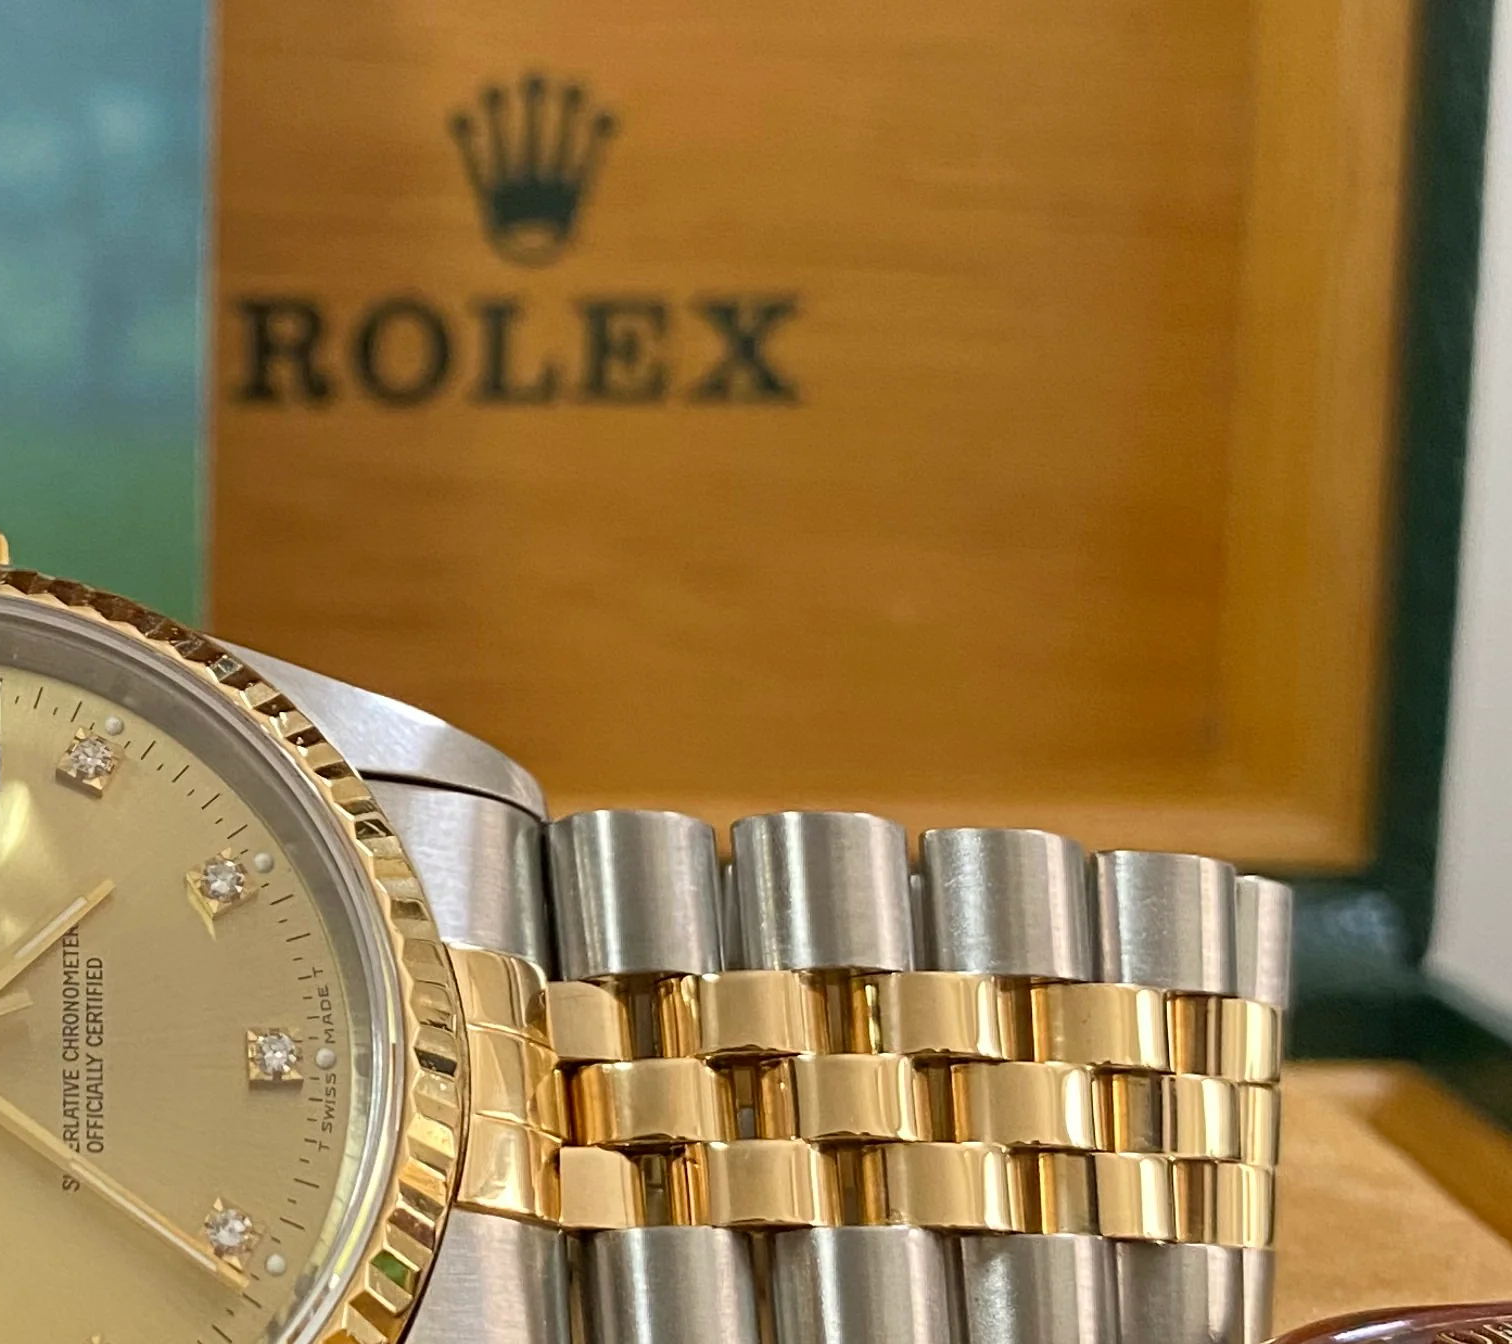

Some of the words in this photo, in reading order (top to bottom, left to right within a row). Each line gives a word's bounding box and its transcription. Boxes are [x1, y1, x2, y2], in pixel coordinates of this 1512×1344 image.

[233, 293, 801, 409] ROLEX
[86, 957, 104, 1048] CERTIFIED
[317, 984, 336, 1044] MADE
[62, 1069, 80, 1192] SERLATIVE
[86, 1056, 104, 1154] OFFICIALLY
[321, 1072, 337, 1133] SWISS
